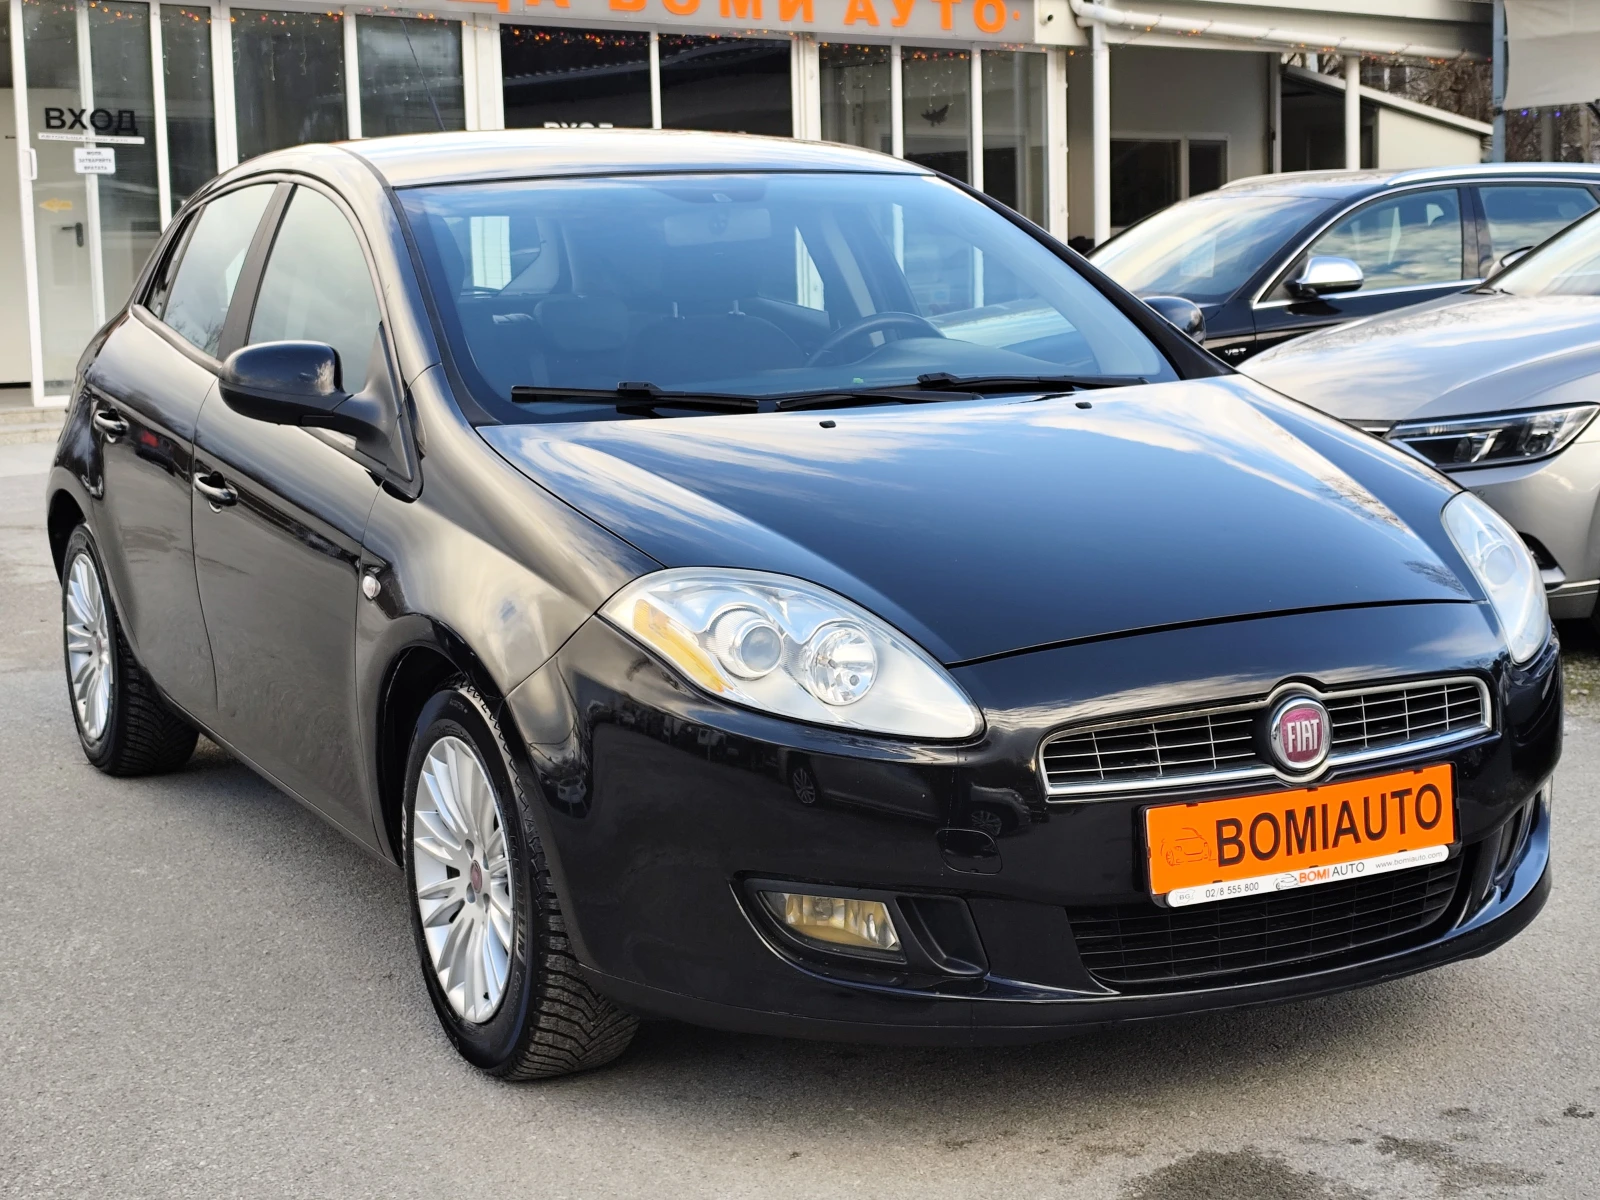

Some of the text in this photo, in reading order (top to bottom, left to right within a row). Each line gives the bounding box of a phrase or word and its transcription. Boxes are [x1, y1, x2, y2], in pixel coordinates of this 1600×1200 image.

[843, 0, 1007, 33] АУТО
[45, 107, 138, 136] ВХОД
[1287, 719, 1320, 753] FIAT
[1215, 783, 1443, 868] BOMIAUTO
[1298, 862, 1365, 884] BOMI AUTO
[1375, 851, 1443, 870] www.bomiauto.com
[1205, 882, 1259, 899] 02/8 555 800
